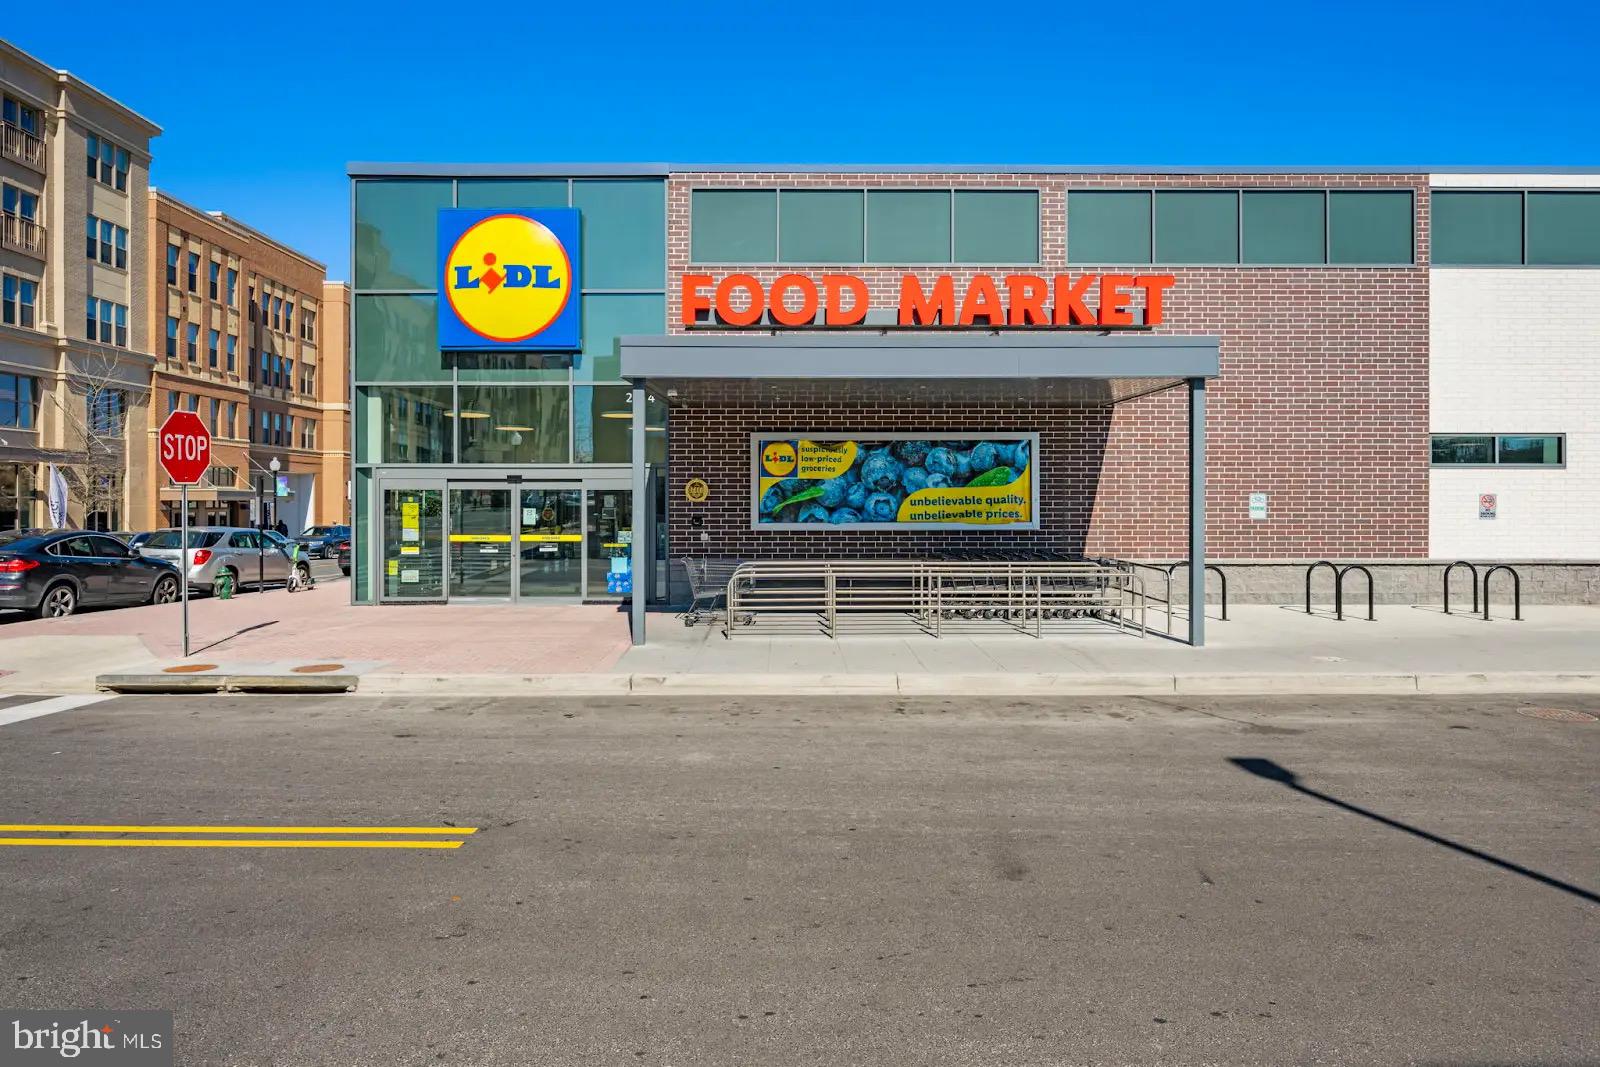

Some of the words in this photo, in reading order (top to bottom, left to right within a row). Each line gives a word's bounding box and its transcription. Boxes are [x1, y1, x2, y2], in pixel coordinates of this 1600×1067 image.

[681, 273, 870, 326] FOOD
[898, 274, 1175, 326] MARKET
[163, 433, 208, 461] STOP
[801, 455, 842, 464] low-priced
[801, 464, 836, 473] groceries
[909, 496, 983, 507] unbelievable
[985, 494, 1026, 507] quality.
[909, 509, 983, 521] unbelievable
[985, 508, 1023, 521] prices.
